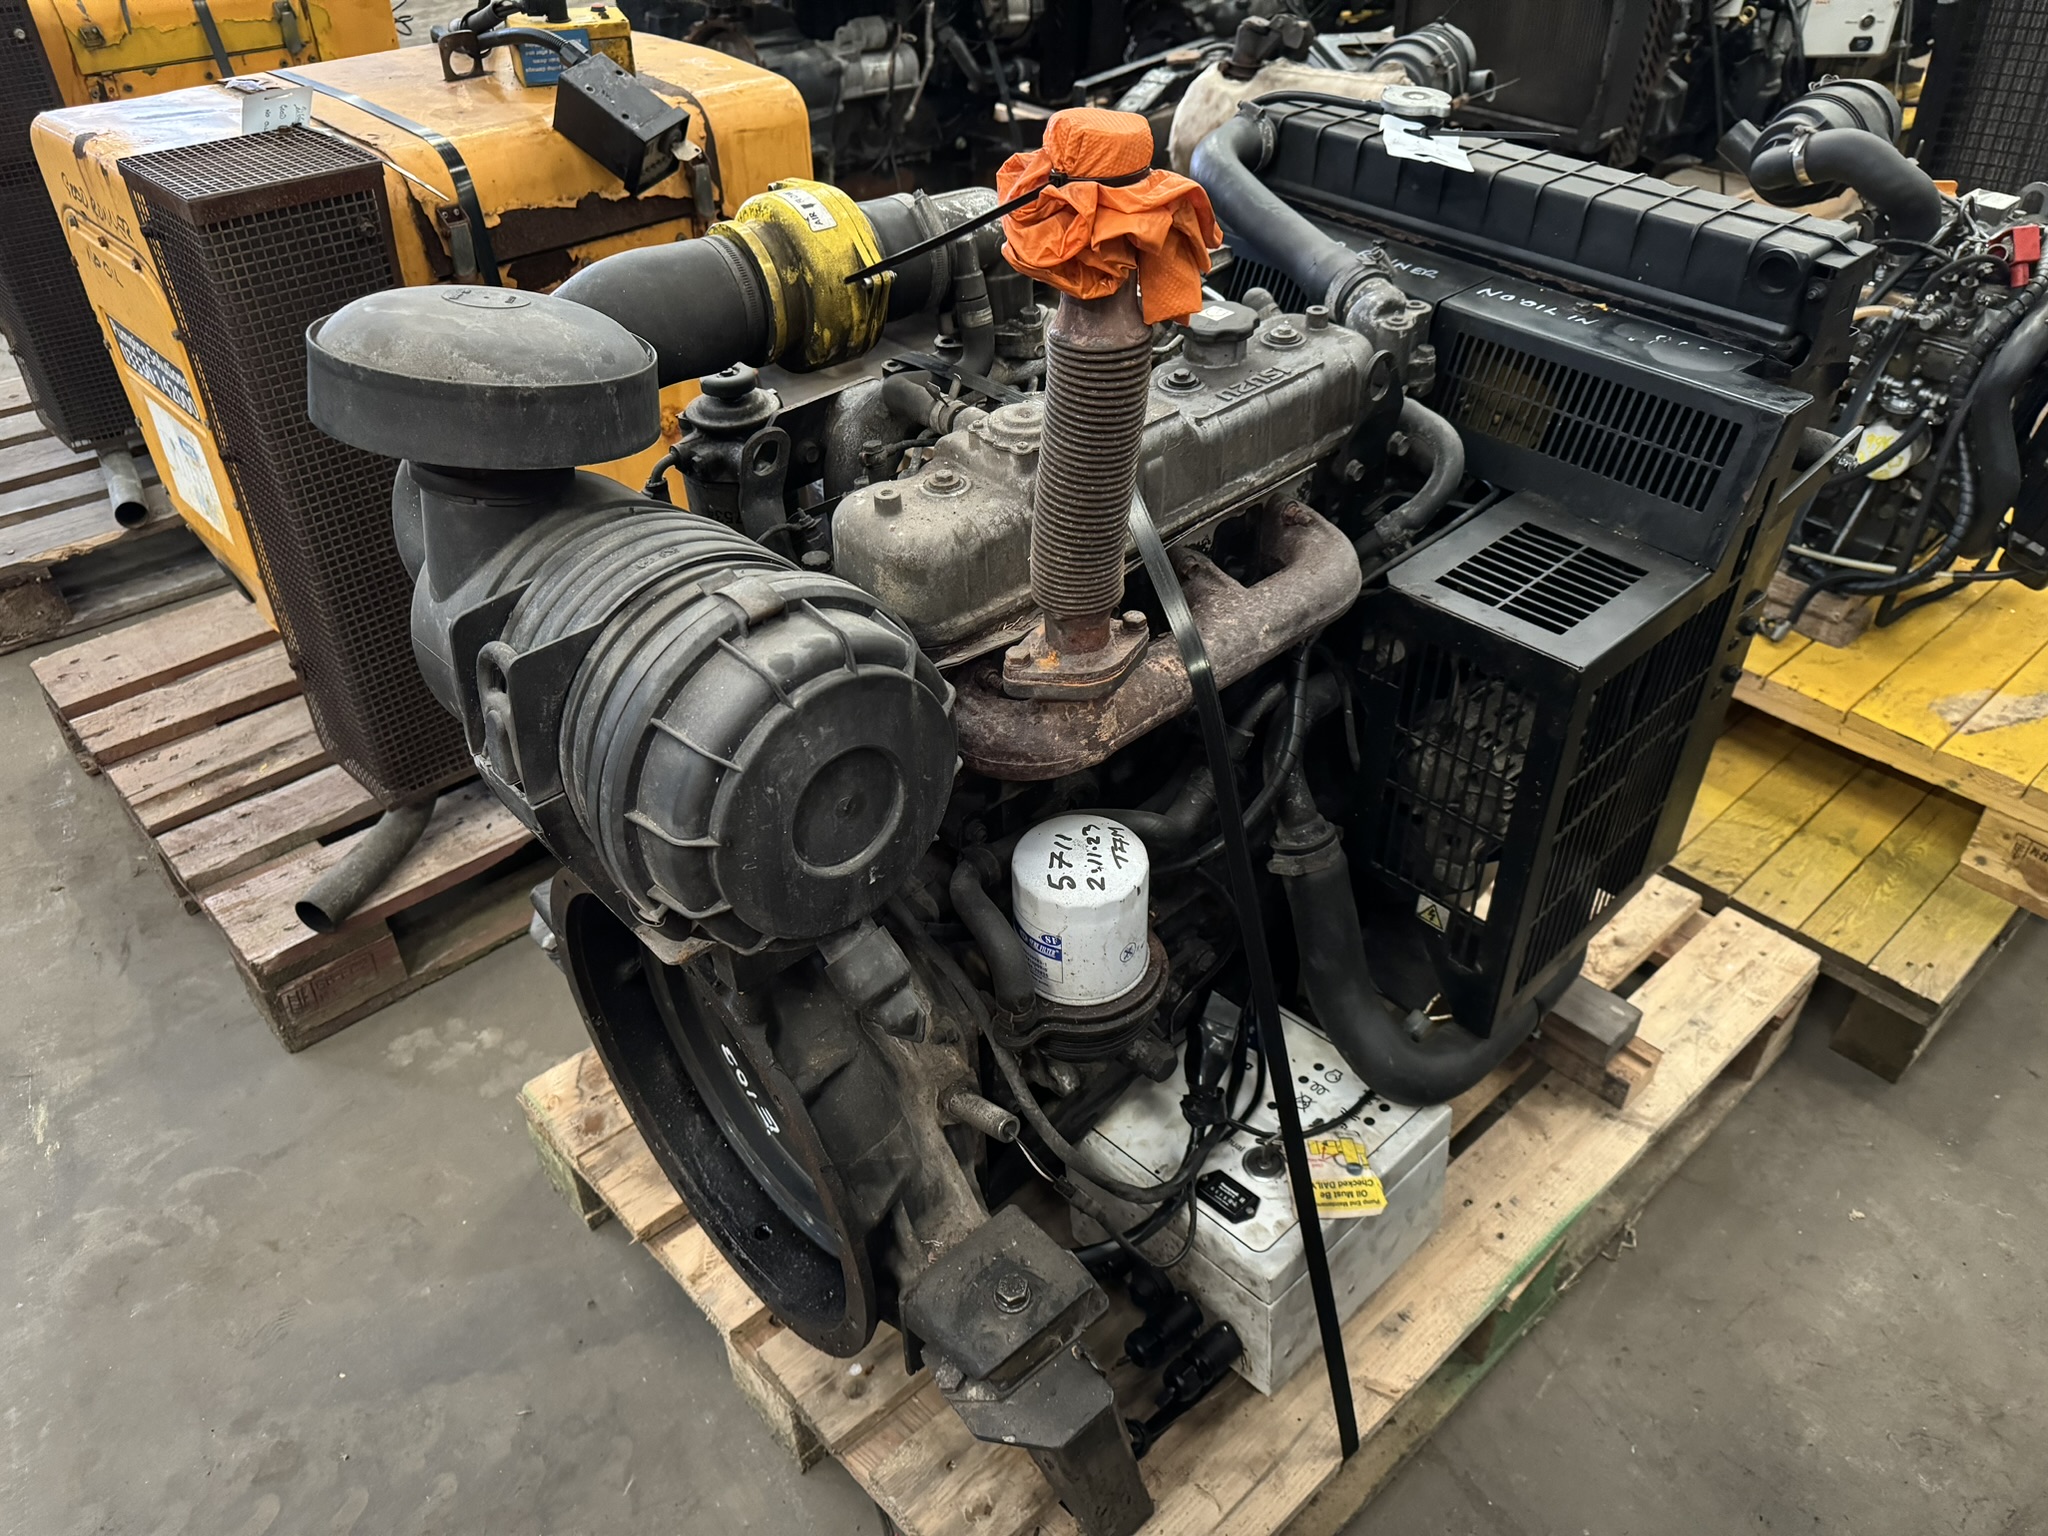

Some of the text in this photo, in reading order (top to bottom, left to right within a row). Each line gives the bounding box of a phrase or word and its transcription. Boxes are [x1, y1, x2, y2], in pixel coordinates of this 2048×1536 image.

[1214, 366, 1292, 402] ISUZU
[1046, 833, 1077, 890] 5711
[1320, 1189, 1368, 1199] Oil Must Be
[1338, 1179, 1374, 1189] Checked
